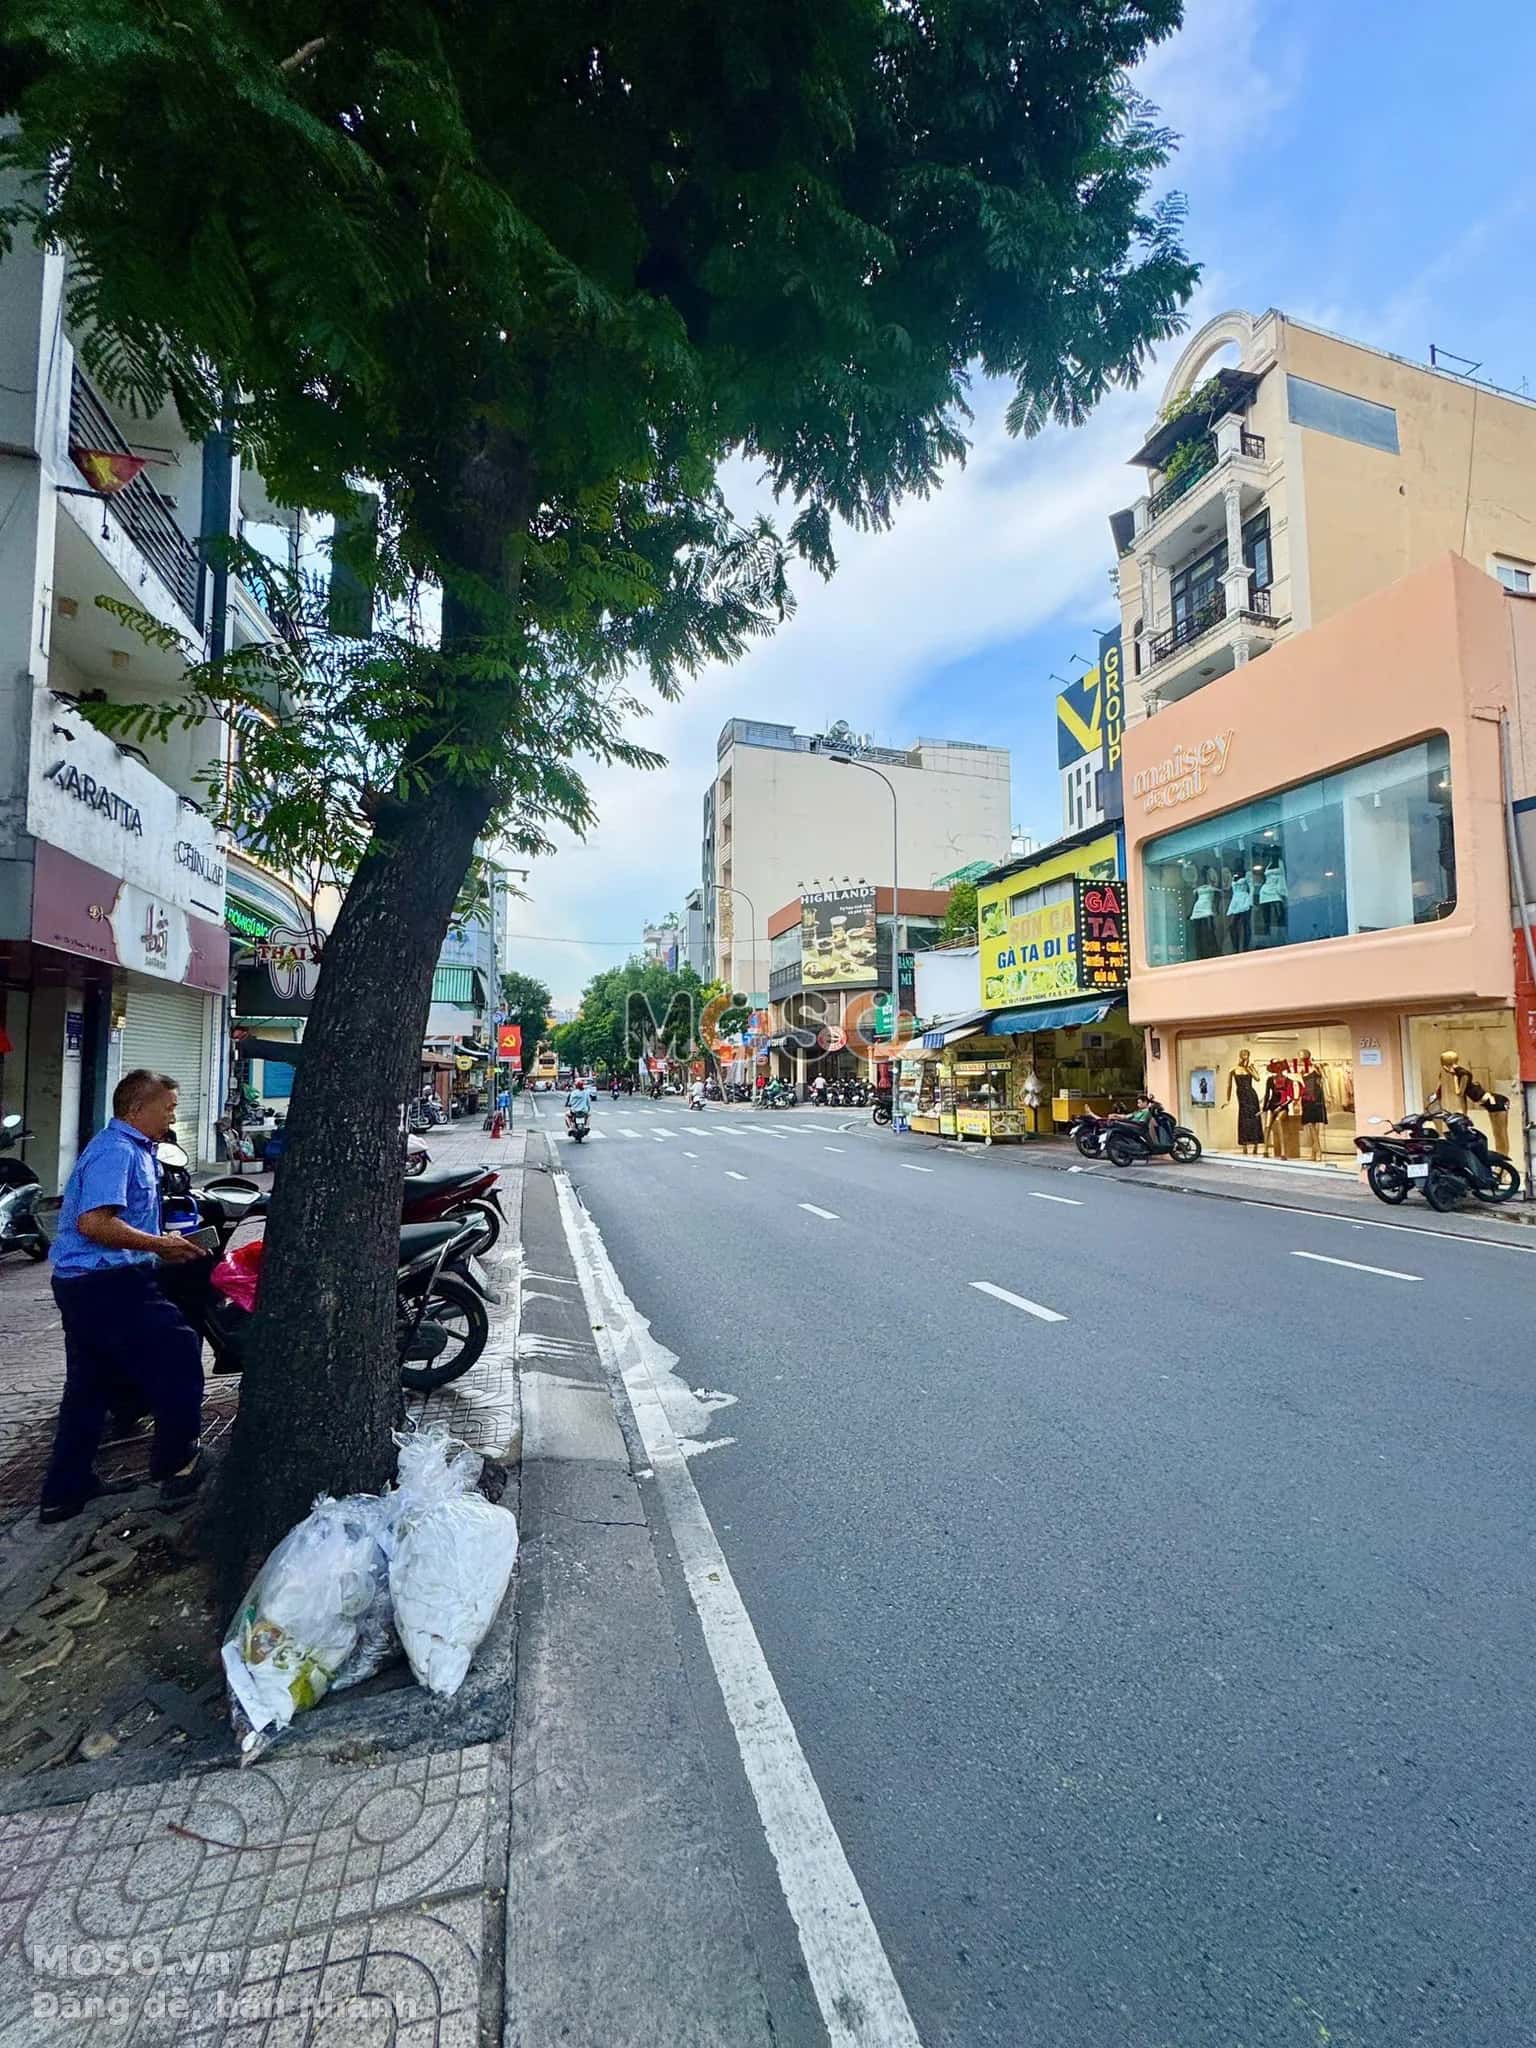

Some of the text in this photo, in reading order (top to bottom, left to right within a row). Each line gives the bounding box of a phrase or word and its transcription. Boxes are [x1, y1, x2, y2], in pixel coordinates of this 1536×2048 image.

[1103, 646, 1121, 773] GROUP
[1131, 728, 1235, 800] maisey
[1084, 887, 1121, 914] GÀ
[1087, 916, 1119, 939] TA
[997, 946, 1016, 969] GÀ
[1020, 943, 1040, 963] TA
